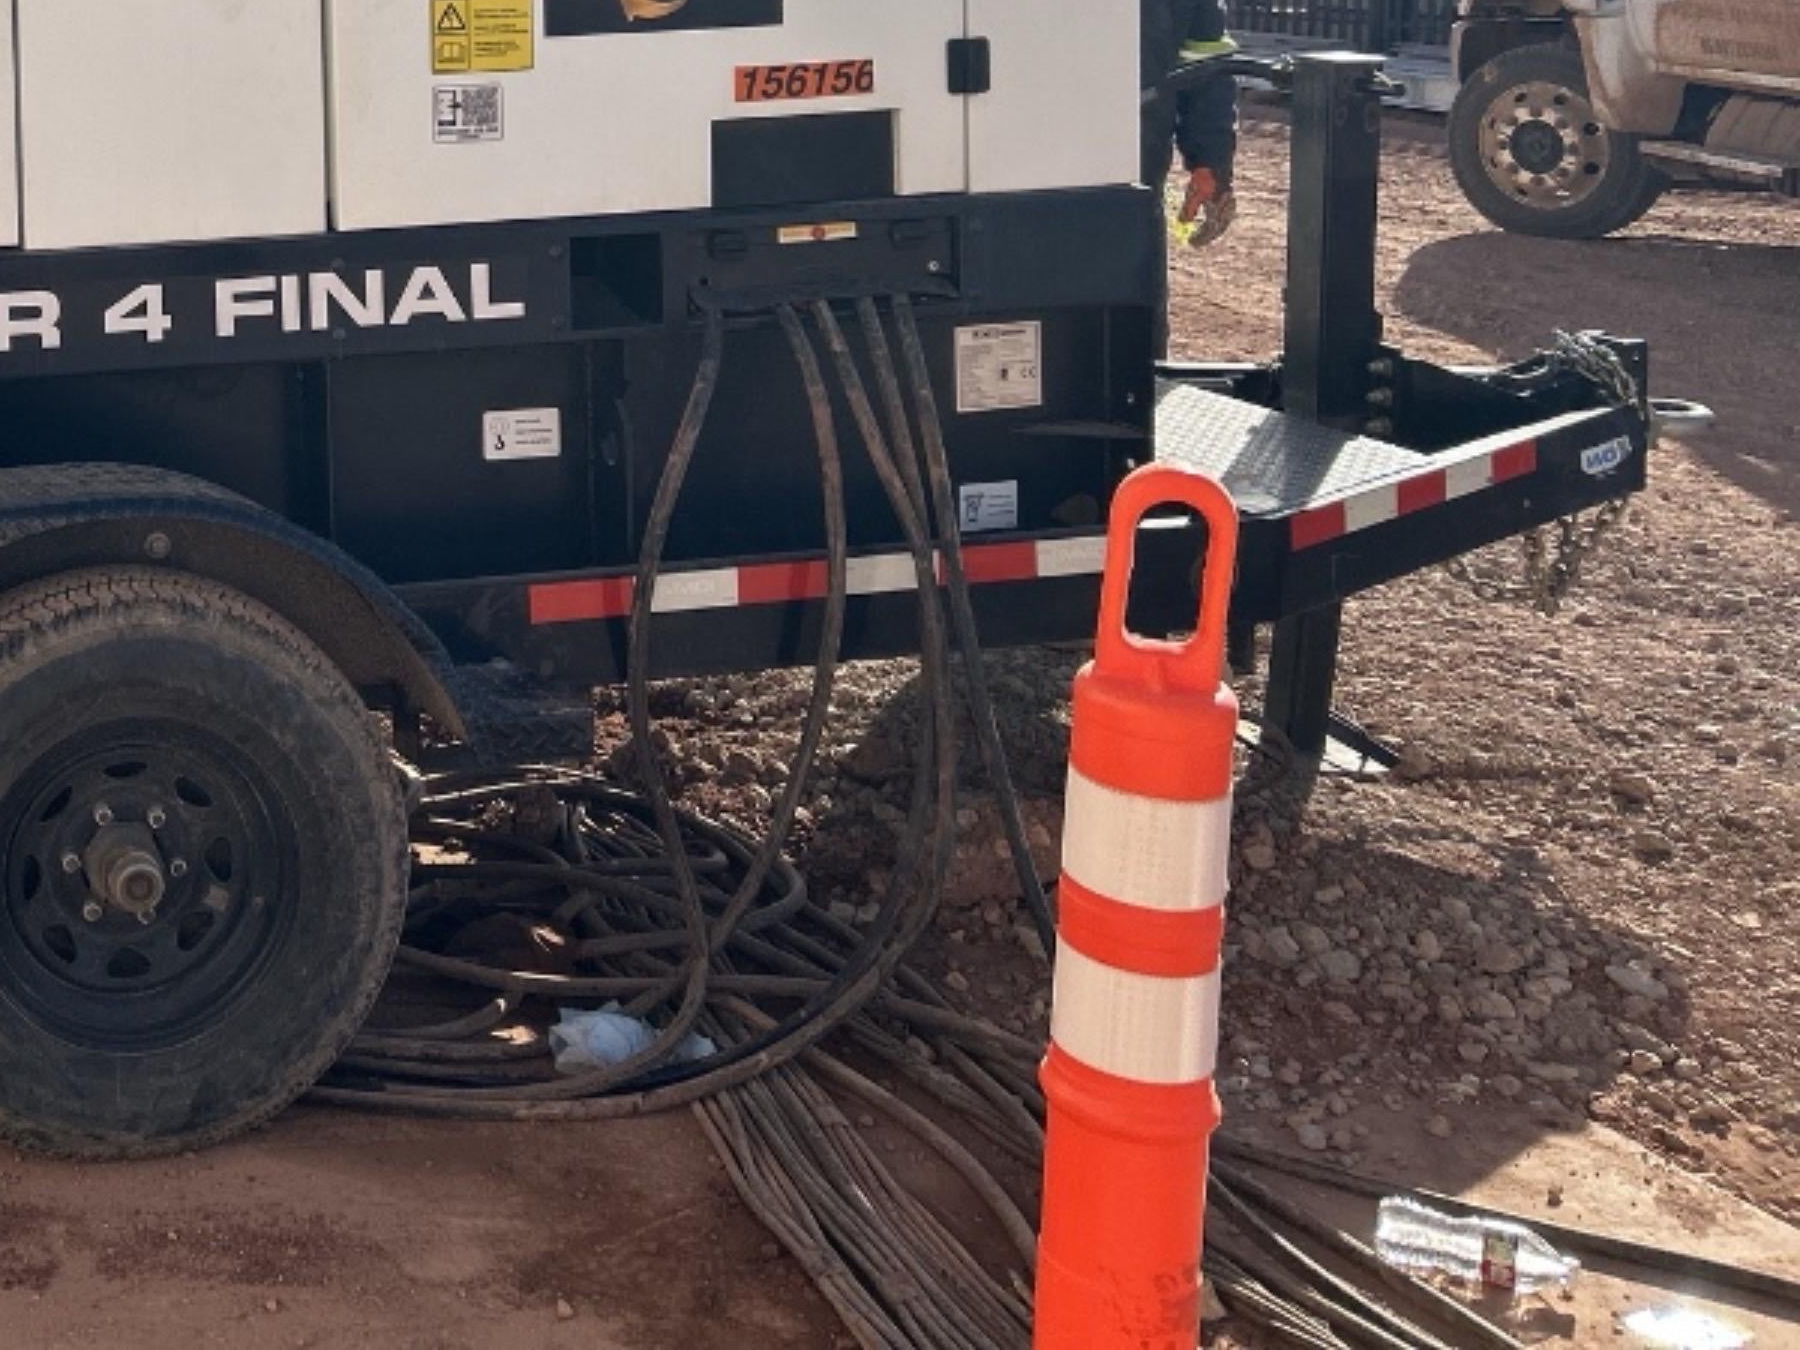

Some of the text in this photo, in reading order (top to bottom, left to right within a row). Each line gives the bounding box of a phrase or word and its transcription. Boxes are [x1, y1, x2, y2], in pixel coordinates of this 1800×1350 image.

[743, 59, 874, 100] 156156
[104, 283, 172, 342] 4
[215, 262, 526, 338] FINAL
